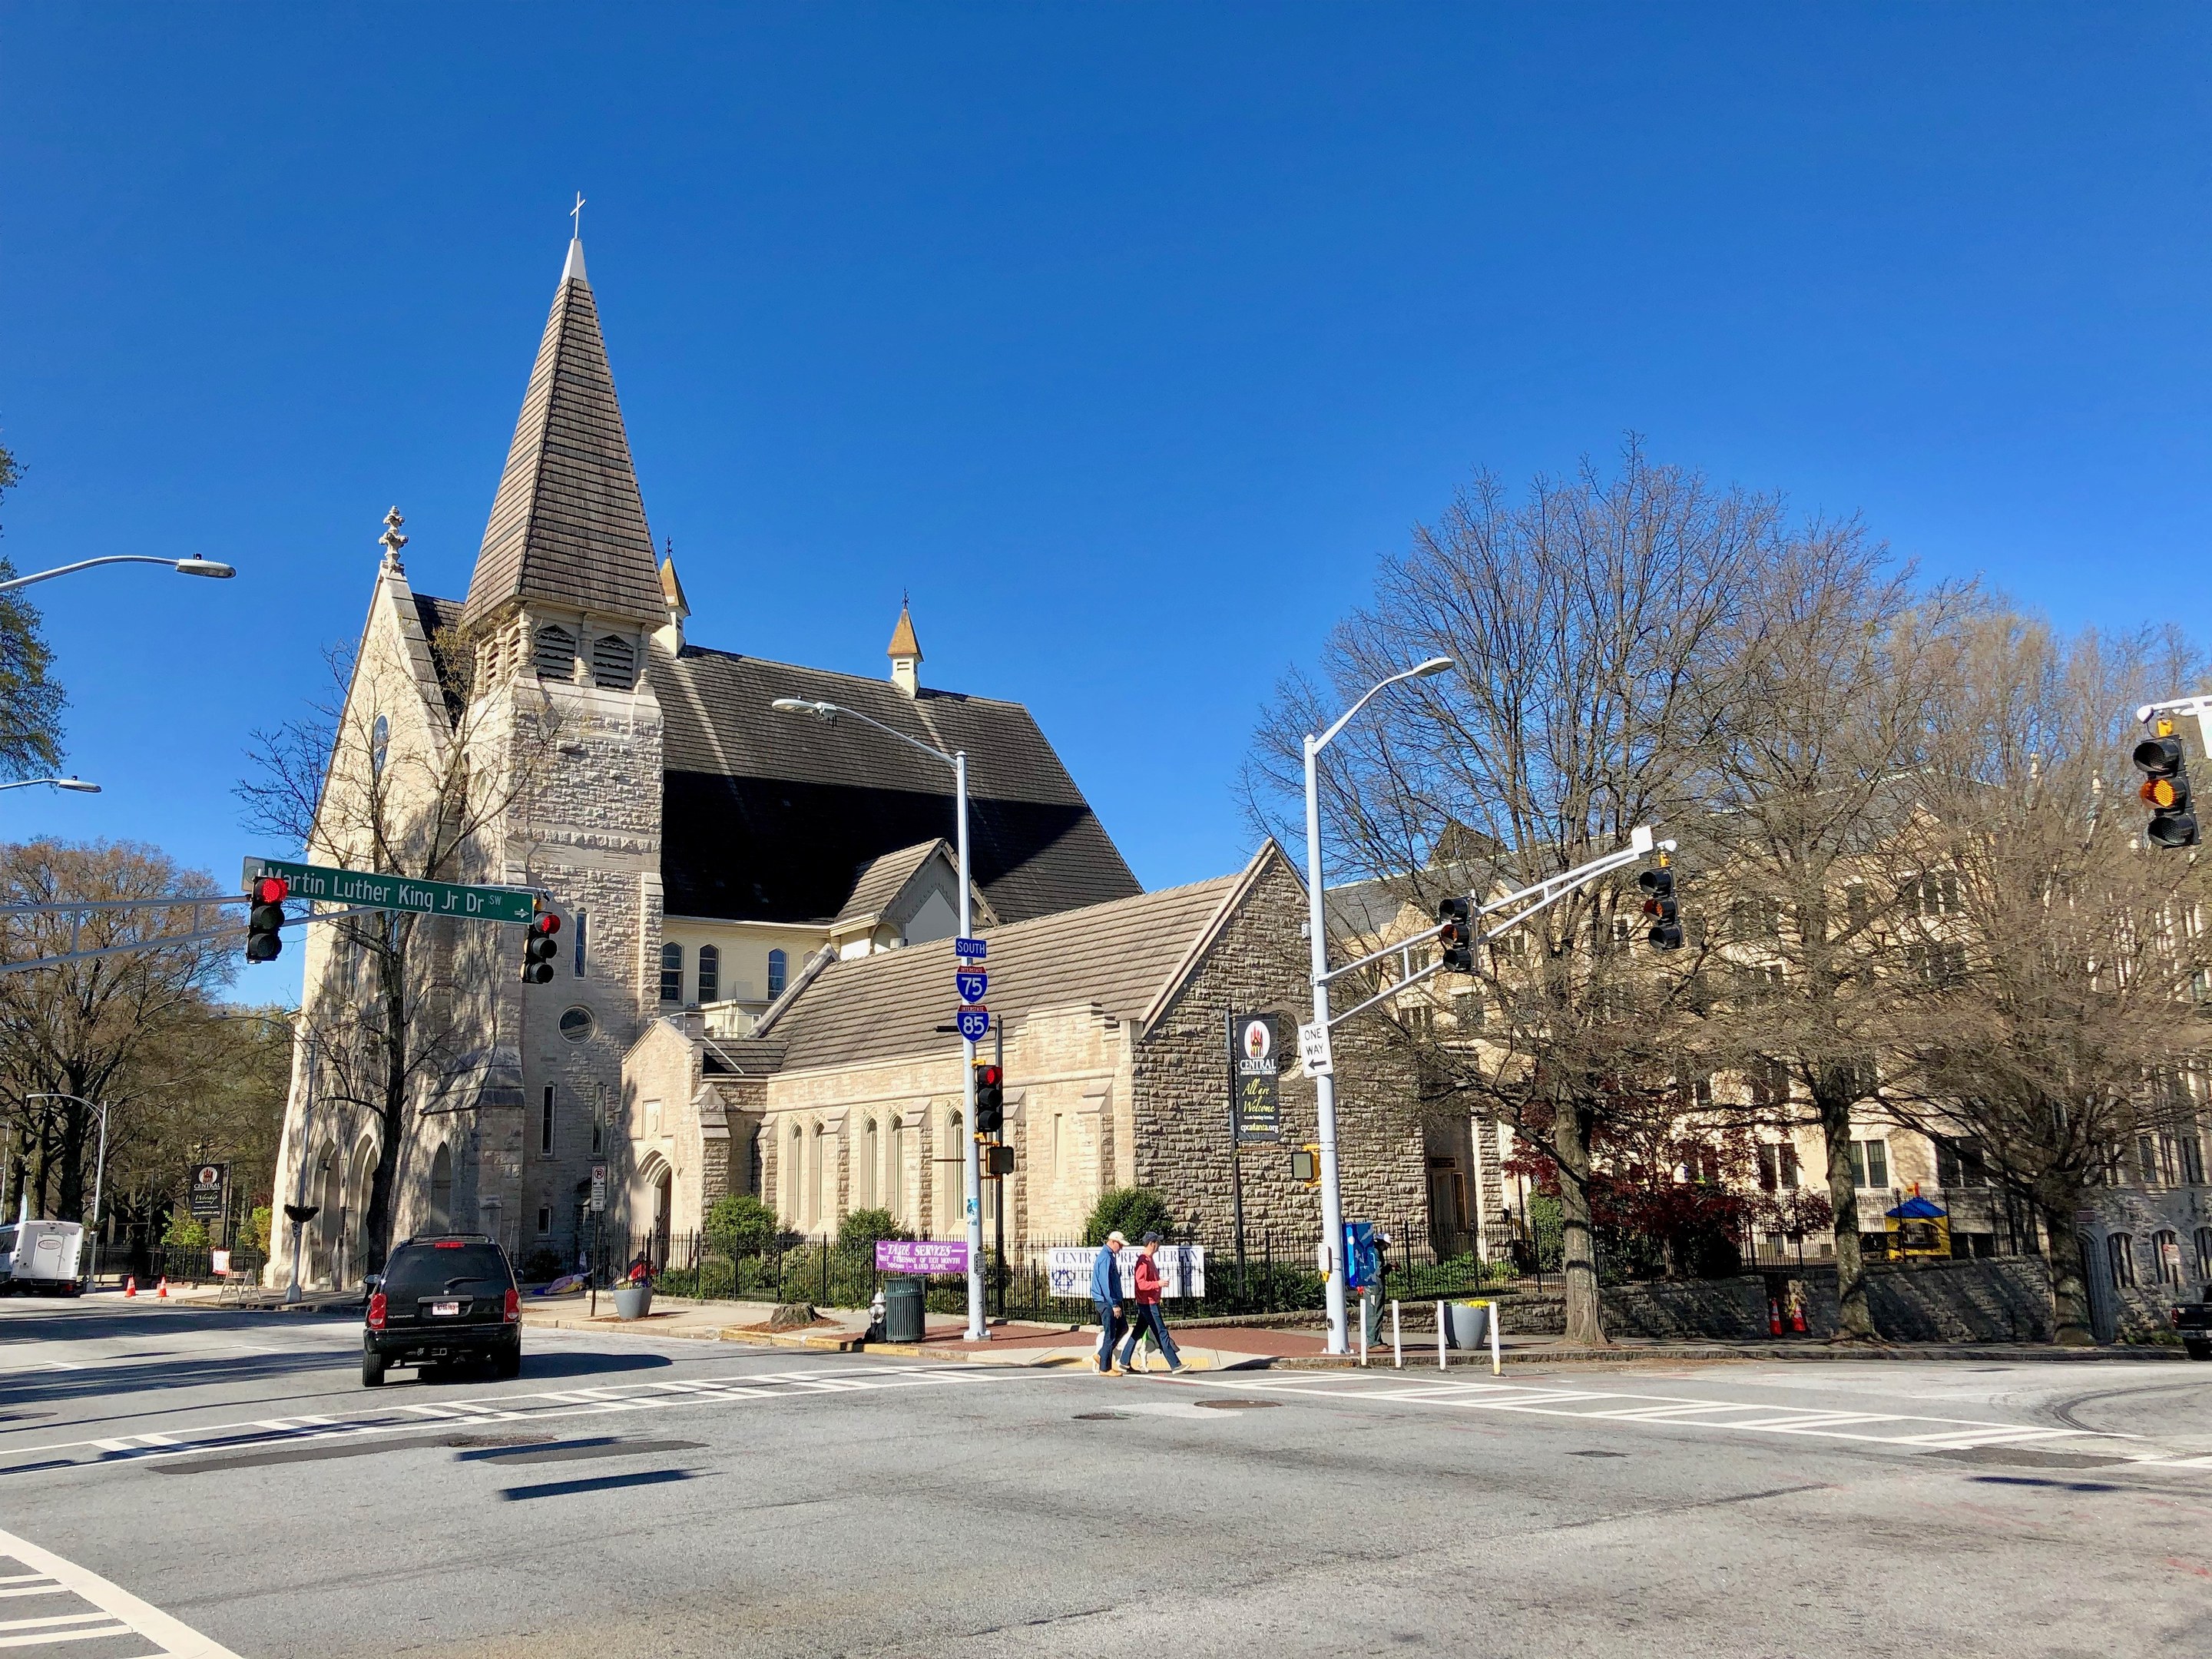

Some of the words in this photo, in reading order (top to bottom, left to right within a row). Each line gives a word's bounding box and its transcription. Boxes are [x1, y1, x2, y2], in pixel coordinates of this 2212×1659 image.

[333, 876, 391, 902] Luther
[398, 884, 434, 913] King
[441, 890, 459, 910] Jr
[466, 892, 485, 913] Dr
[489, 895, 502, 906] SW
[957, 941, 985, 955] SOUTH
[962, 977, 982, 996] 75
[963, 1016, 985, 1035] 85
[1305, 1028, 1323, 1041] ONE
[1306, 1042, 1324, 1056] WAY
[1240, 1058, 1277, 1070] CENTRAL
[1242, 1078, 1260, 1096] All
[1243, 1095, 1276, 1113] Welcome
[914, 1244, 952, 1257] SERVICES
